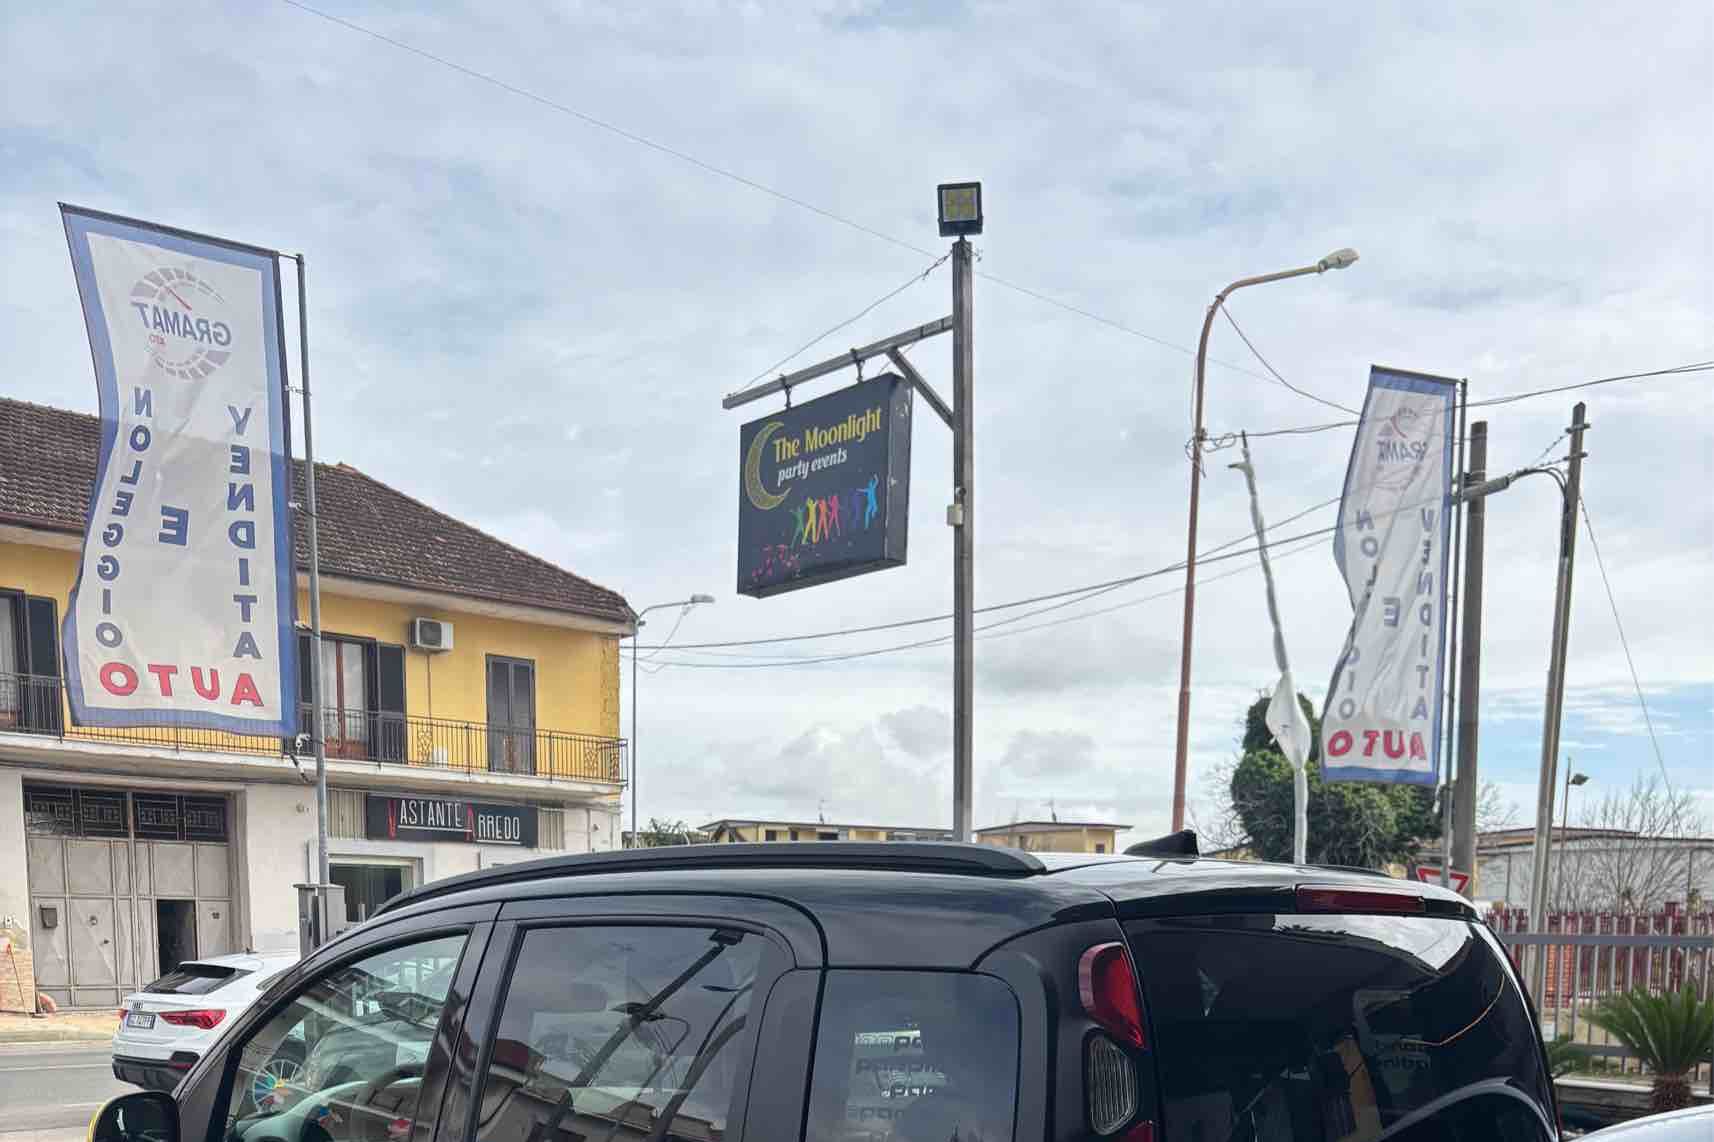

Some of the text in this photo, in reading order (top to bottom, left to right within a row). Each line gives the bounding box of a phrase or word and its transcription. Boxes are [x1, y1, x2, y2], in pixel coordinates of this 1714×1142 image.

[773, 407, 882, 464] The Moonlight
[777, 447, 848, 487] party events
[464, 800, 521, 843] ARREDO
